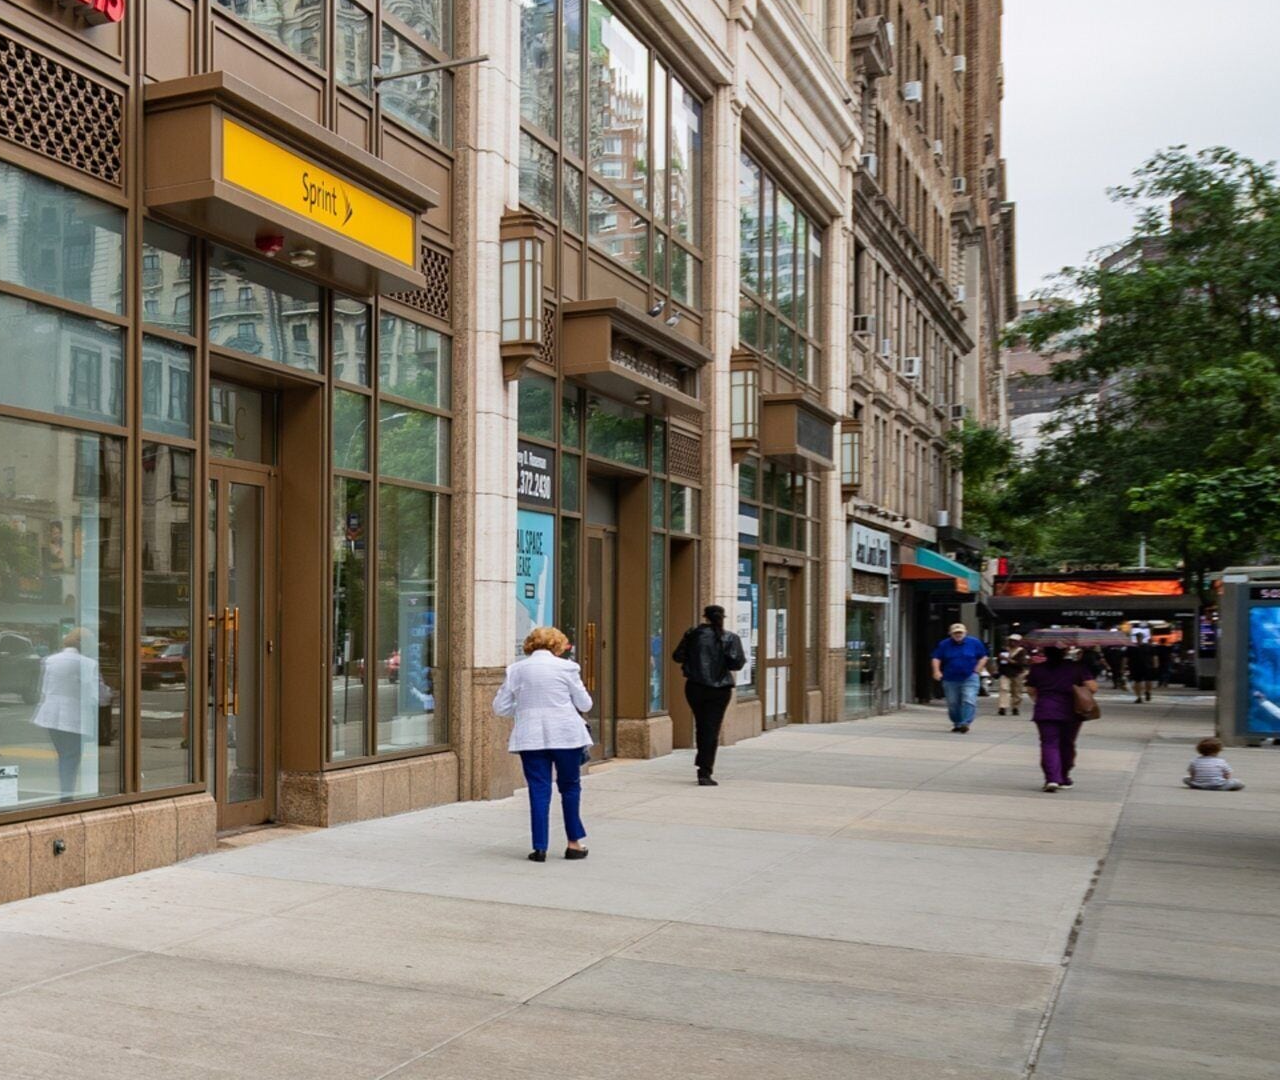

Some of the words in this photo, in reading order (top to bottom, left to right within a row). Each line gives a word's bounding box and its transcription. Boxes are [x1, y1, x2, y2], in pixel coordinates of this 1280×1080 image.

[302, 172, 338, 217] Sprint
[517, 470, 551, 500] .372.2430
[525, 530, 544, 556] SPACE
